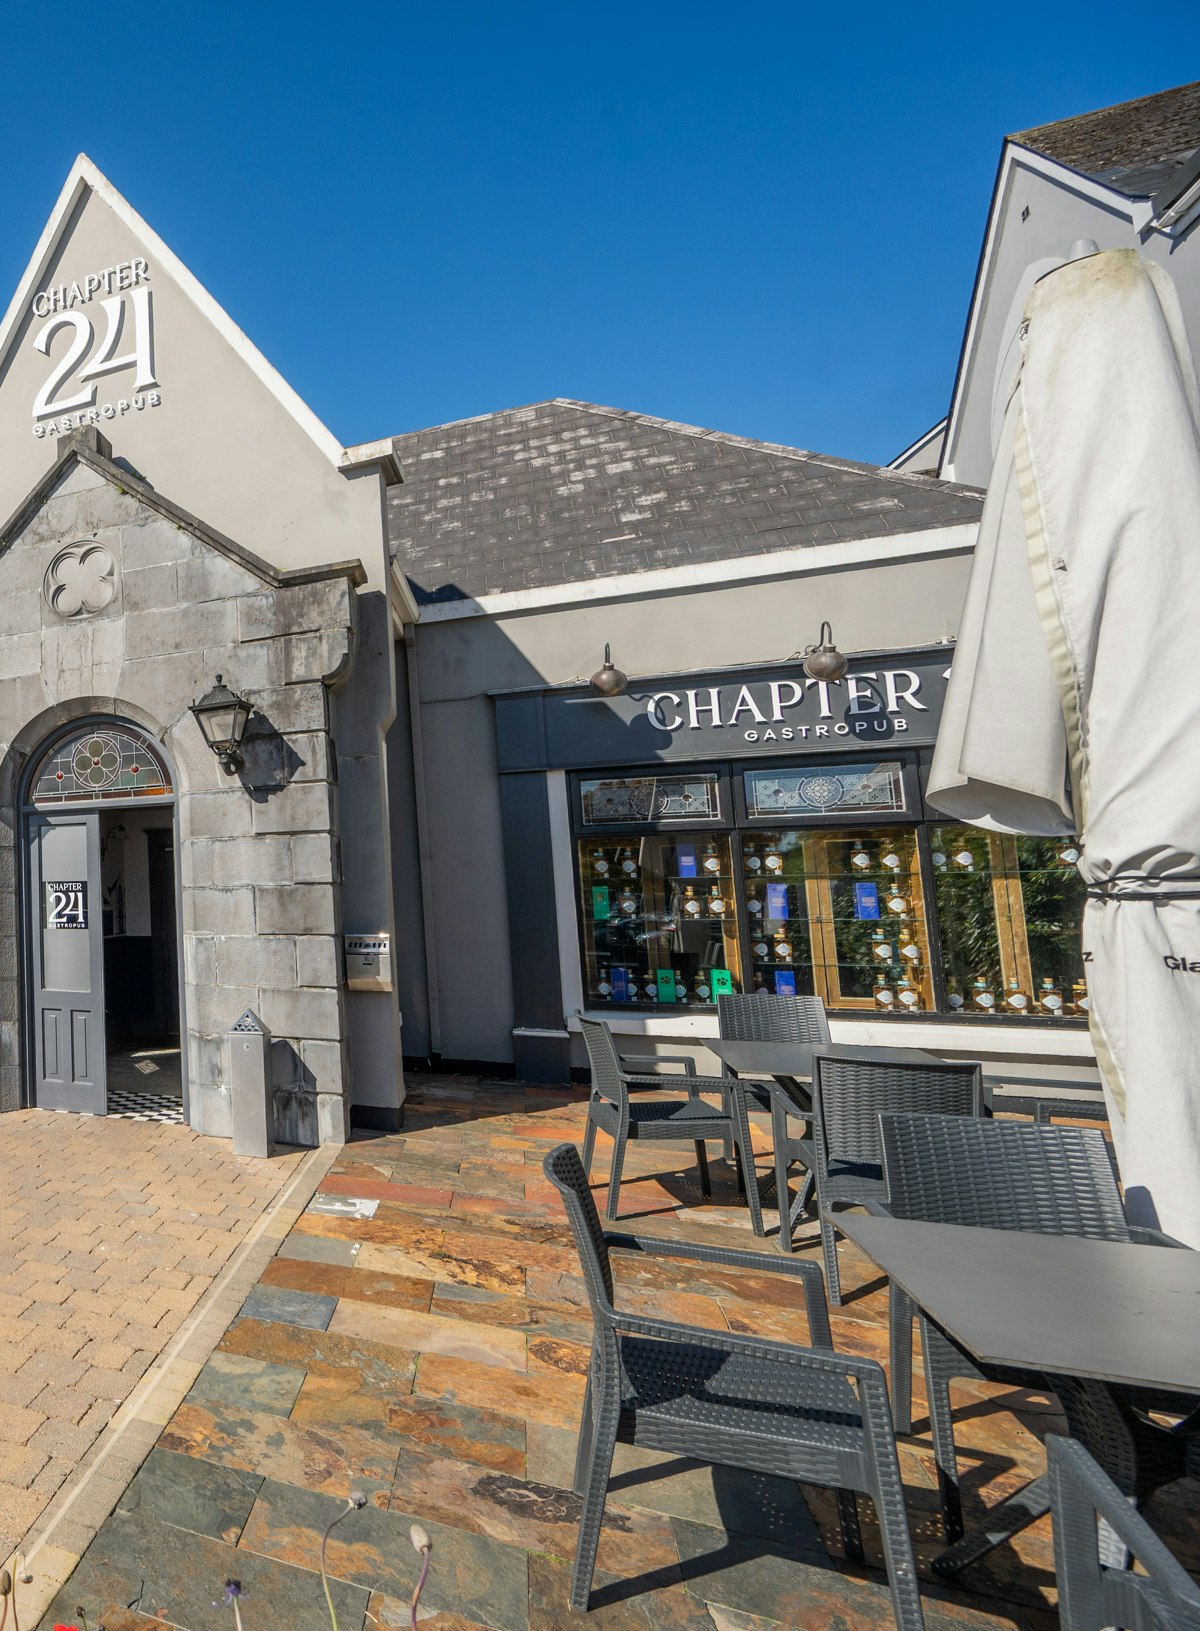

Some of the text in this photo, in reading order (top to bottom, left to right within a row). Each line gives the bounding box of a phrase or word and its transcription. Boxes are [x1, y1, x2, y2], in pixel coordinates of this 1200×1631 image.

[32, 257, 149, 316] CHAPTER
[31, 285, 157, 418] 24
[32, 390, 160, 437] GASTROPUB
[647, 670, 928, 731] CHAPTER
[744, 718, 908, 742] GASTROPUB
[48, 882, 82, 890] CHAPTER
[48, 892, 85, 922] 24
